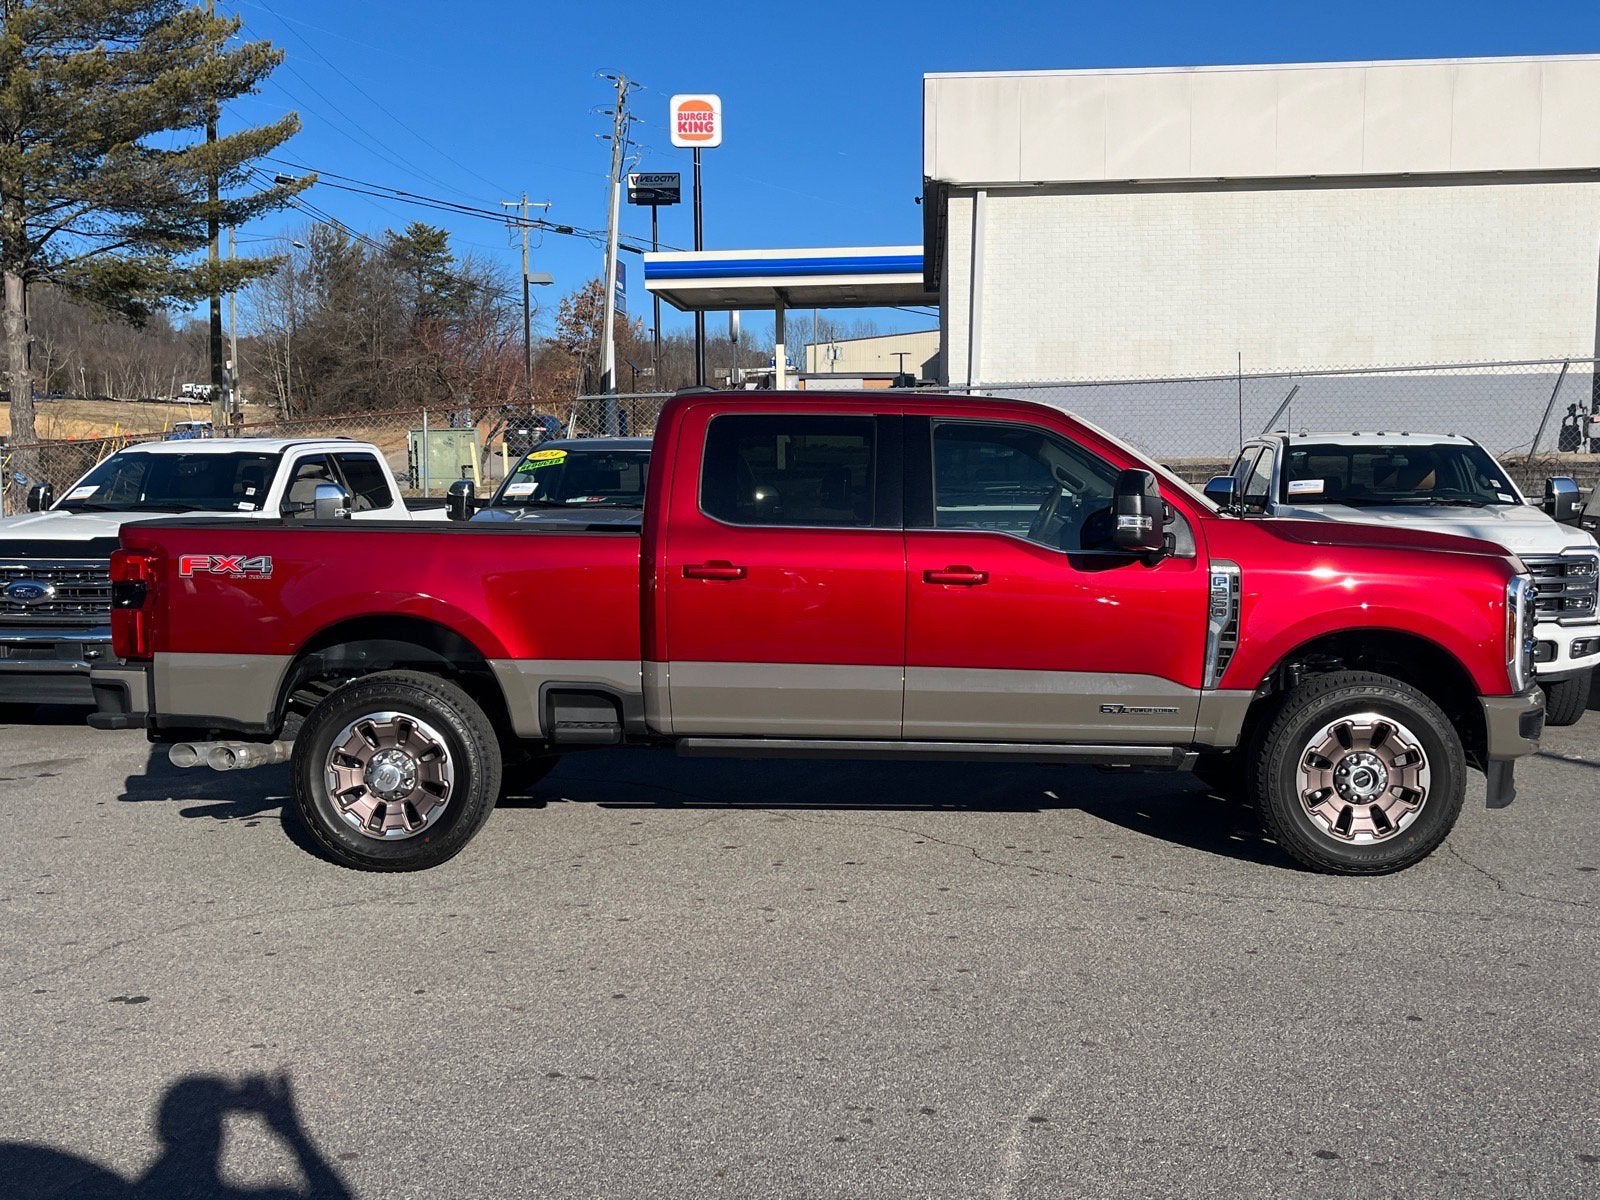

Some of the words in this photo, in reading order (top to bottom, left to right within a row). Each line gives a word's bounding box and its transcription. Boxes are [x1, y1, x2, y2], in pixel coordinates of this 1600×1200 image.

[677, 112, 714, 121] BURGER
[677, 121, 714, 133] KING
[639, 175, 678, 183] VELOCITY
[179, 554, 273, 578] FX4
[1130, 703, 1152, 713] POWER
[1153, 703, 1178, 713] STROKE
